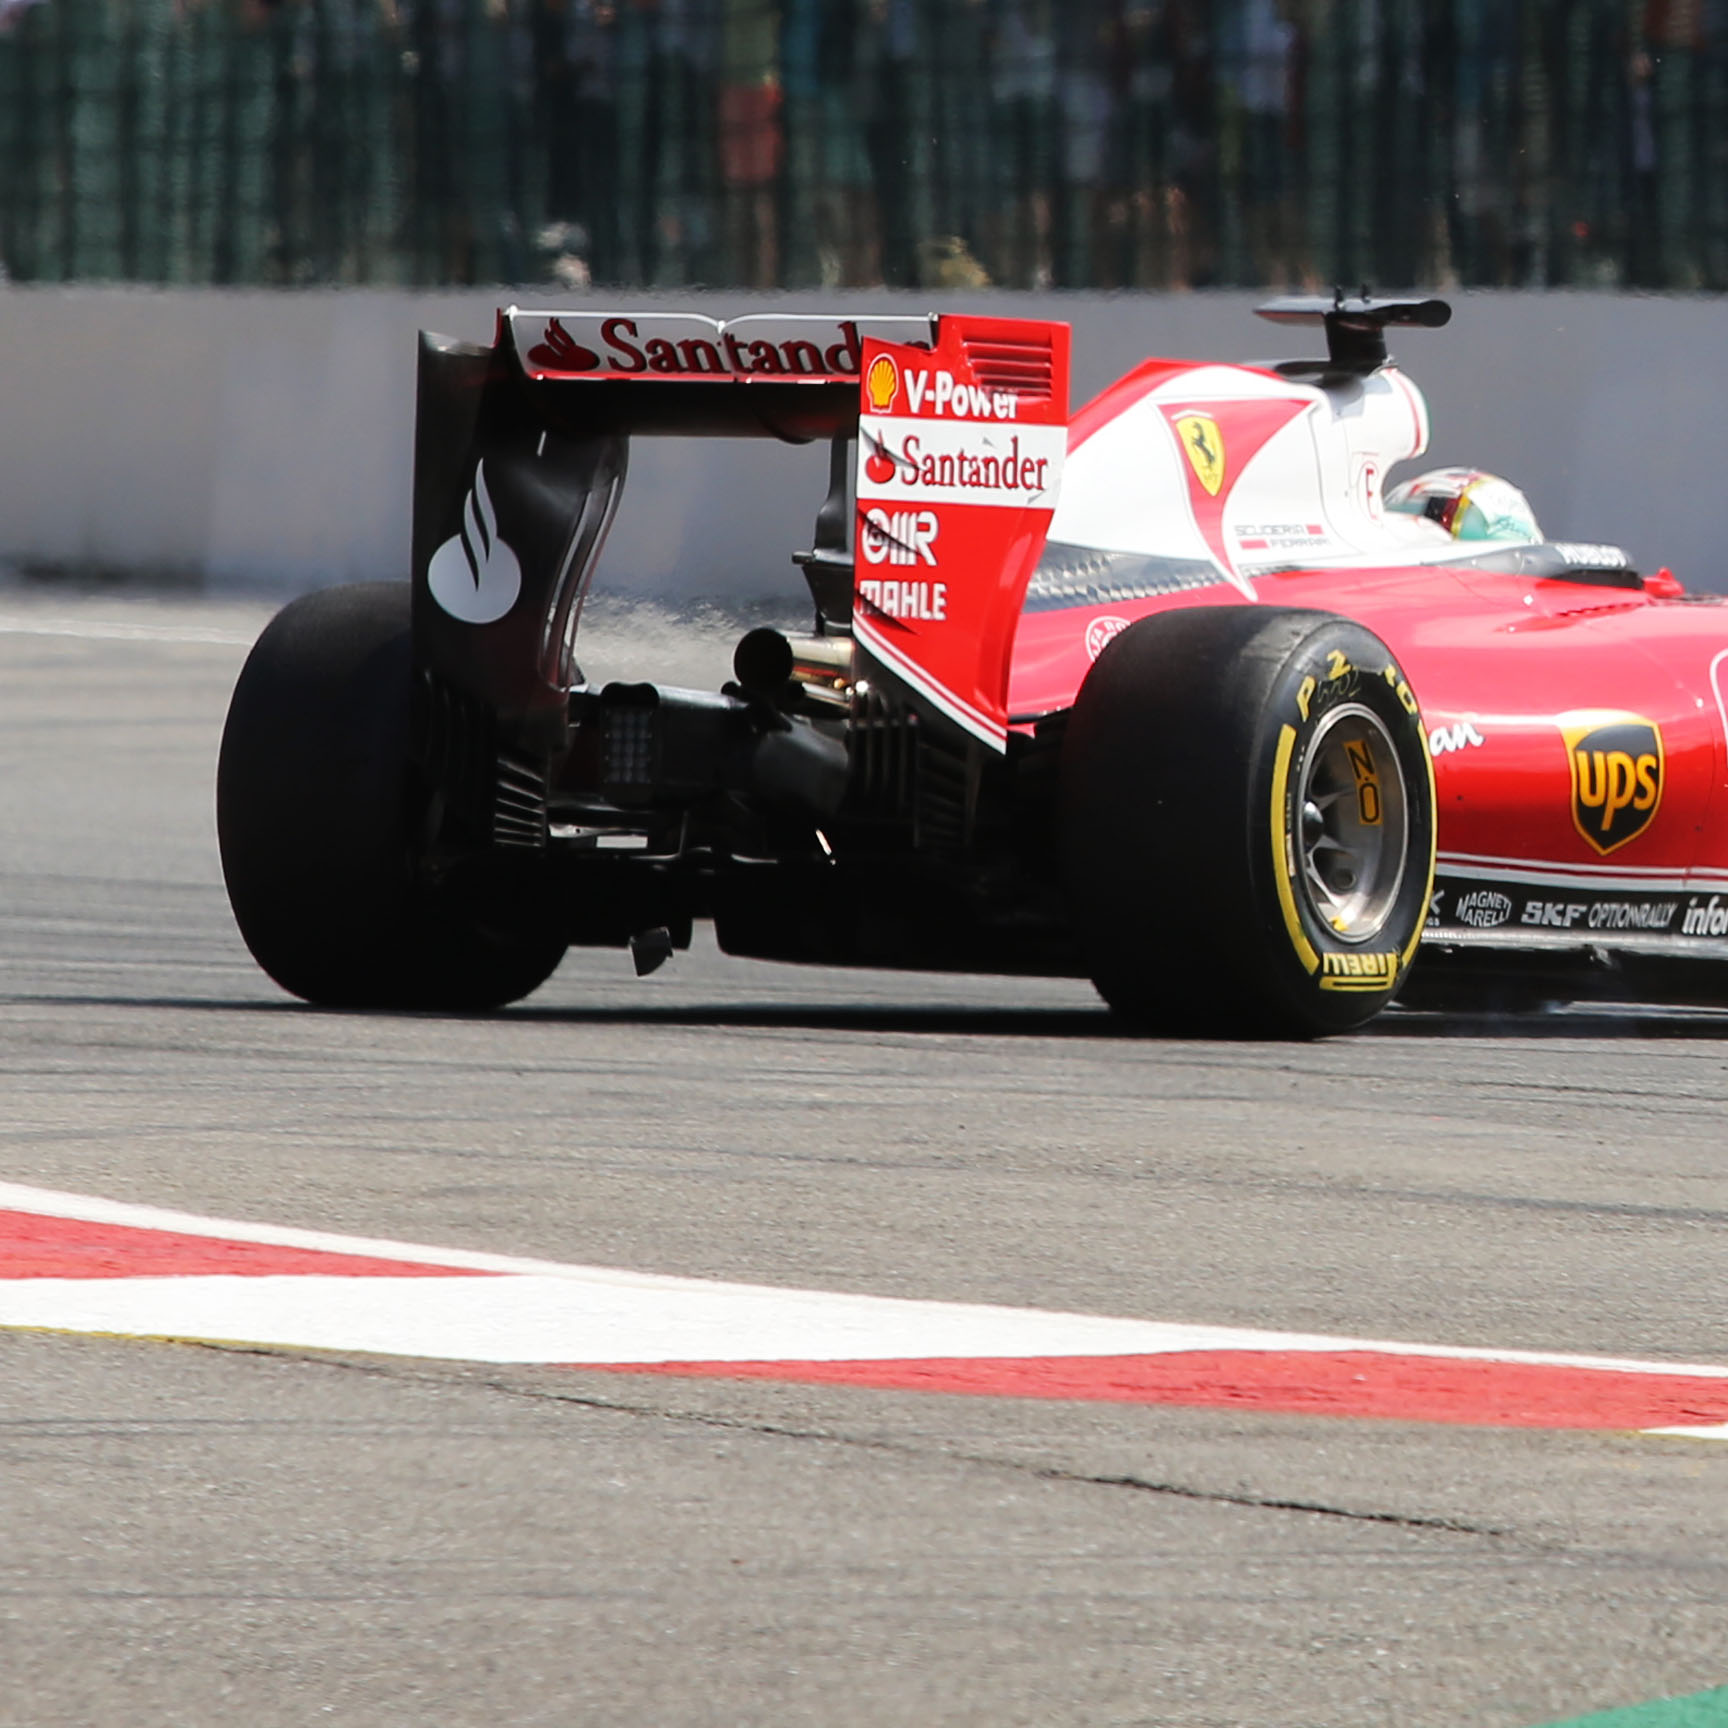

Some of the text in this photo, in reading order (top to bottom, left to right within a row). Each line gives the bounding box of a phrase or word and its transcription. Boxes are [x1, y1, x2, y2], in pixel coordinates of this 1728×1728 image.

[600, 317, 930, 376] Santand
[903, 369, 1018, 419] V-Power
[902, 434, 1048, 491] Santander
[859, 580, 946, 621] MAHLE
[1576, 750, 1657, 831] ups
[1521, 902, 1588, 927] SKF
